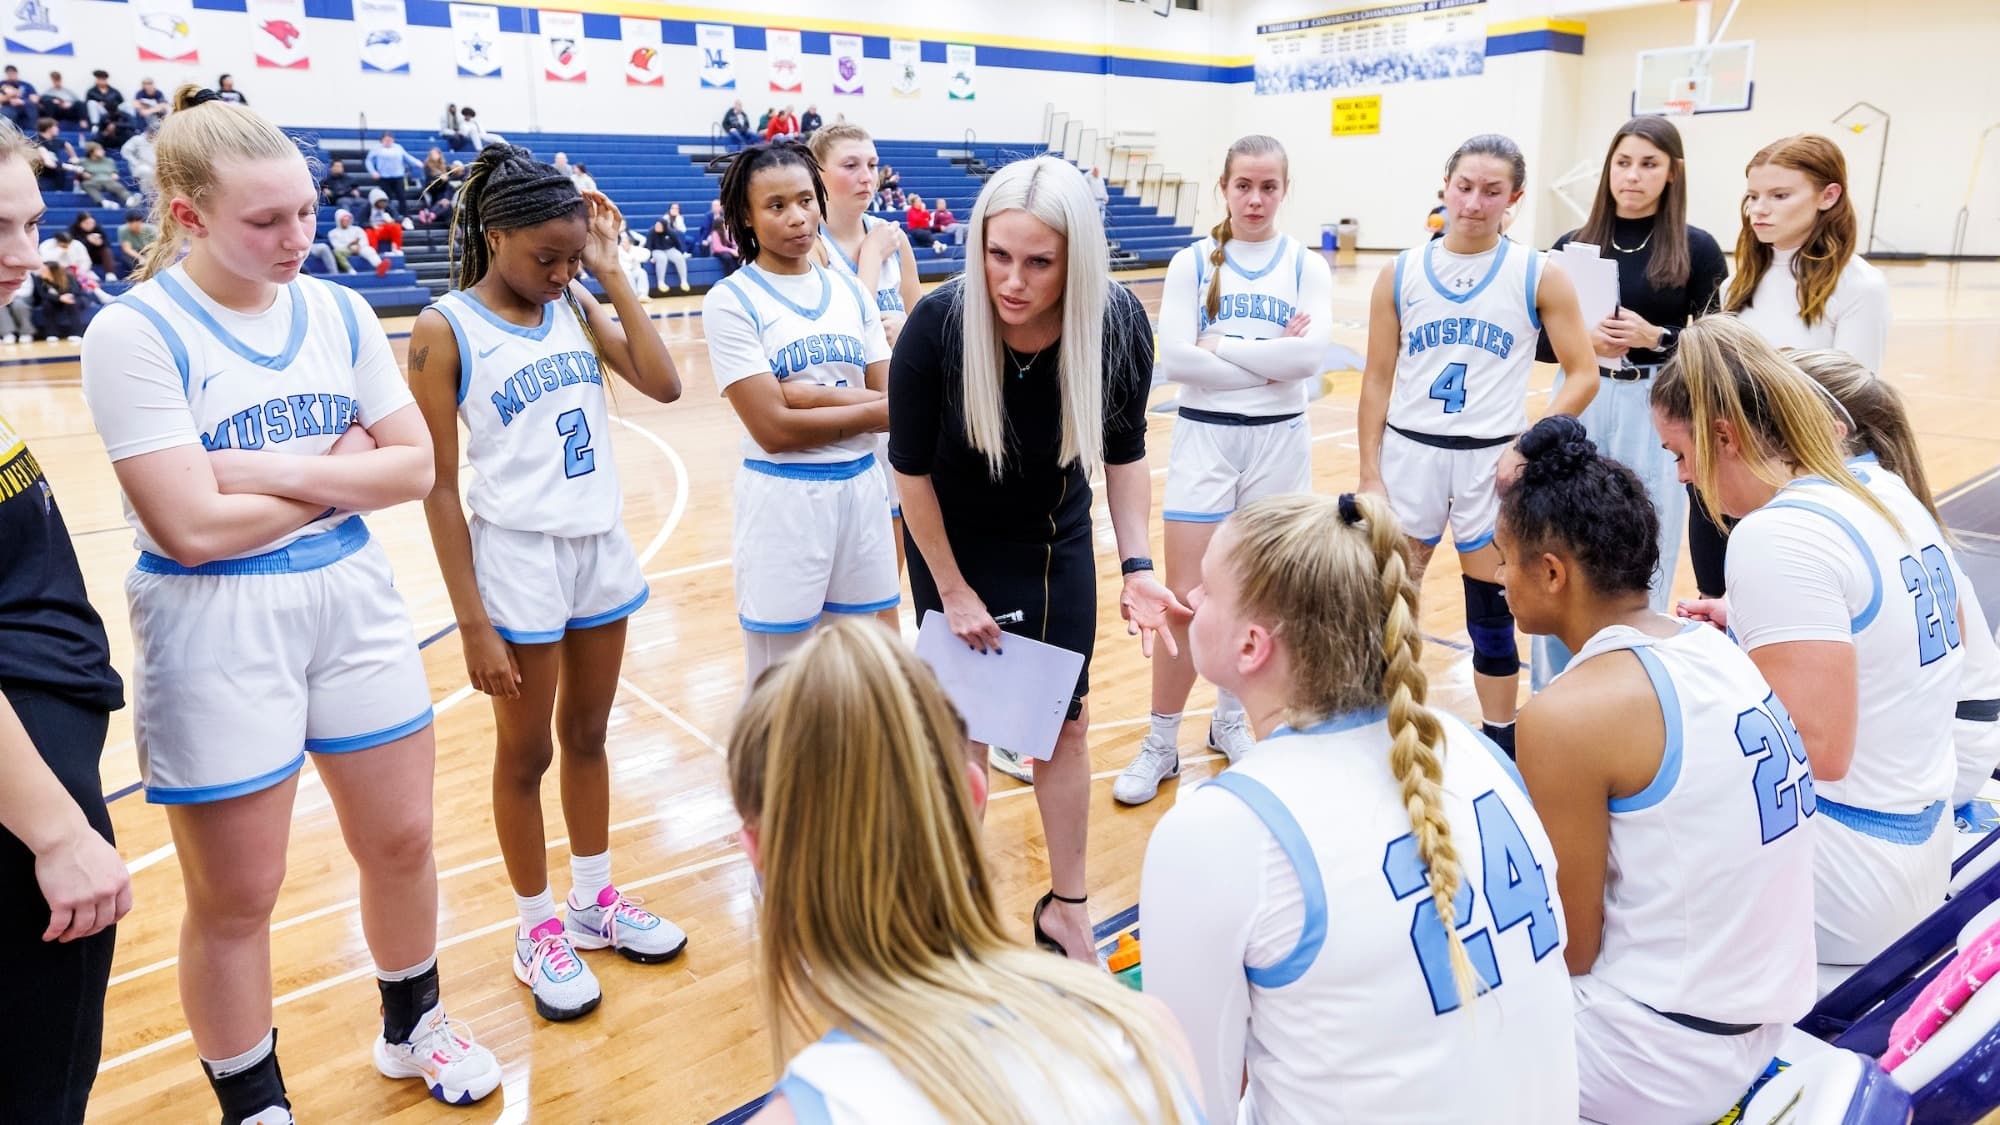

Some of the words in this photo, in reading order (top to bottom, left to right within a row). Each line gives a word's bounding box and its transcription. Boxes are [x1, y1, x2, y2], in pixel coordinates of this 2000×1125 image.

[768, 333, 867, 379] MUSKIE
[1408, 317, 1515, 360] MUSKIES
[490, 350, 603, 428] MUSKIE
[1429, 362, 1468, 414] 4
[556, 407, 596, 480] 2
[1899, 543, 1961, 668] 20
[1382, 788, 1560, 1016] 24
